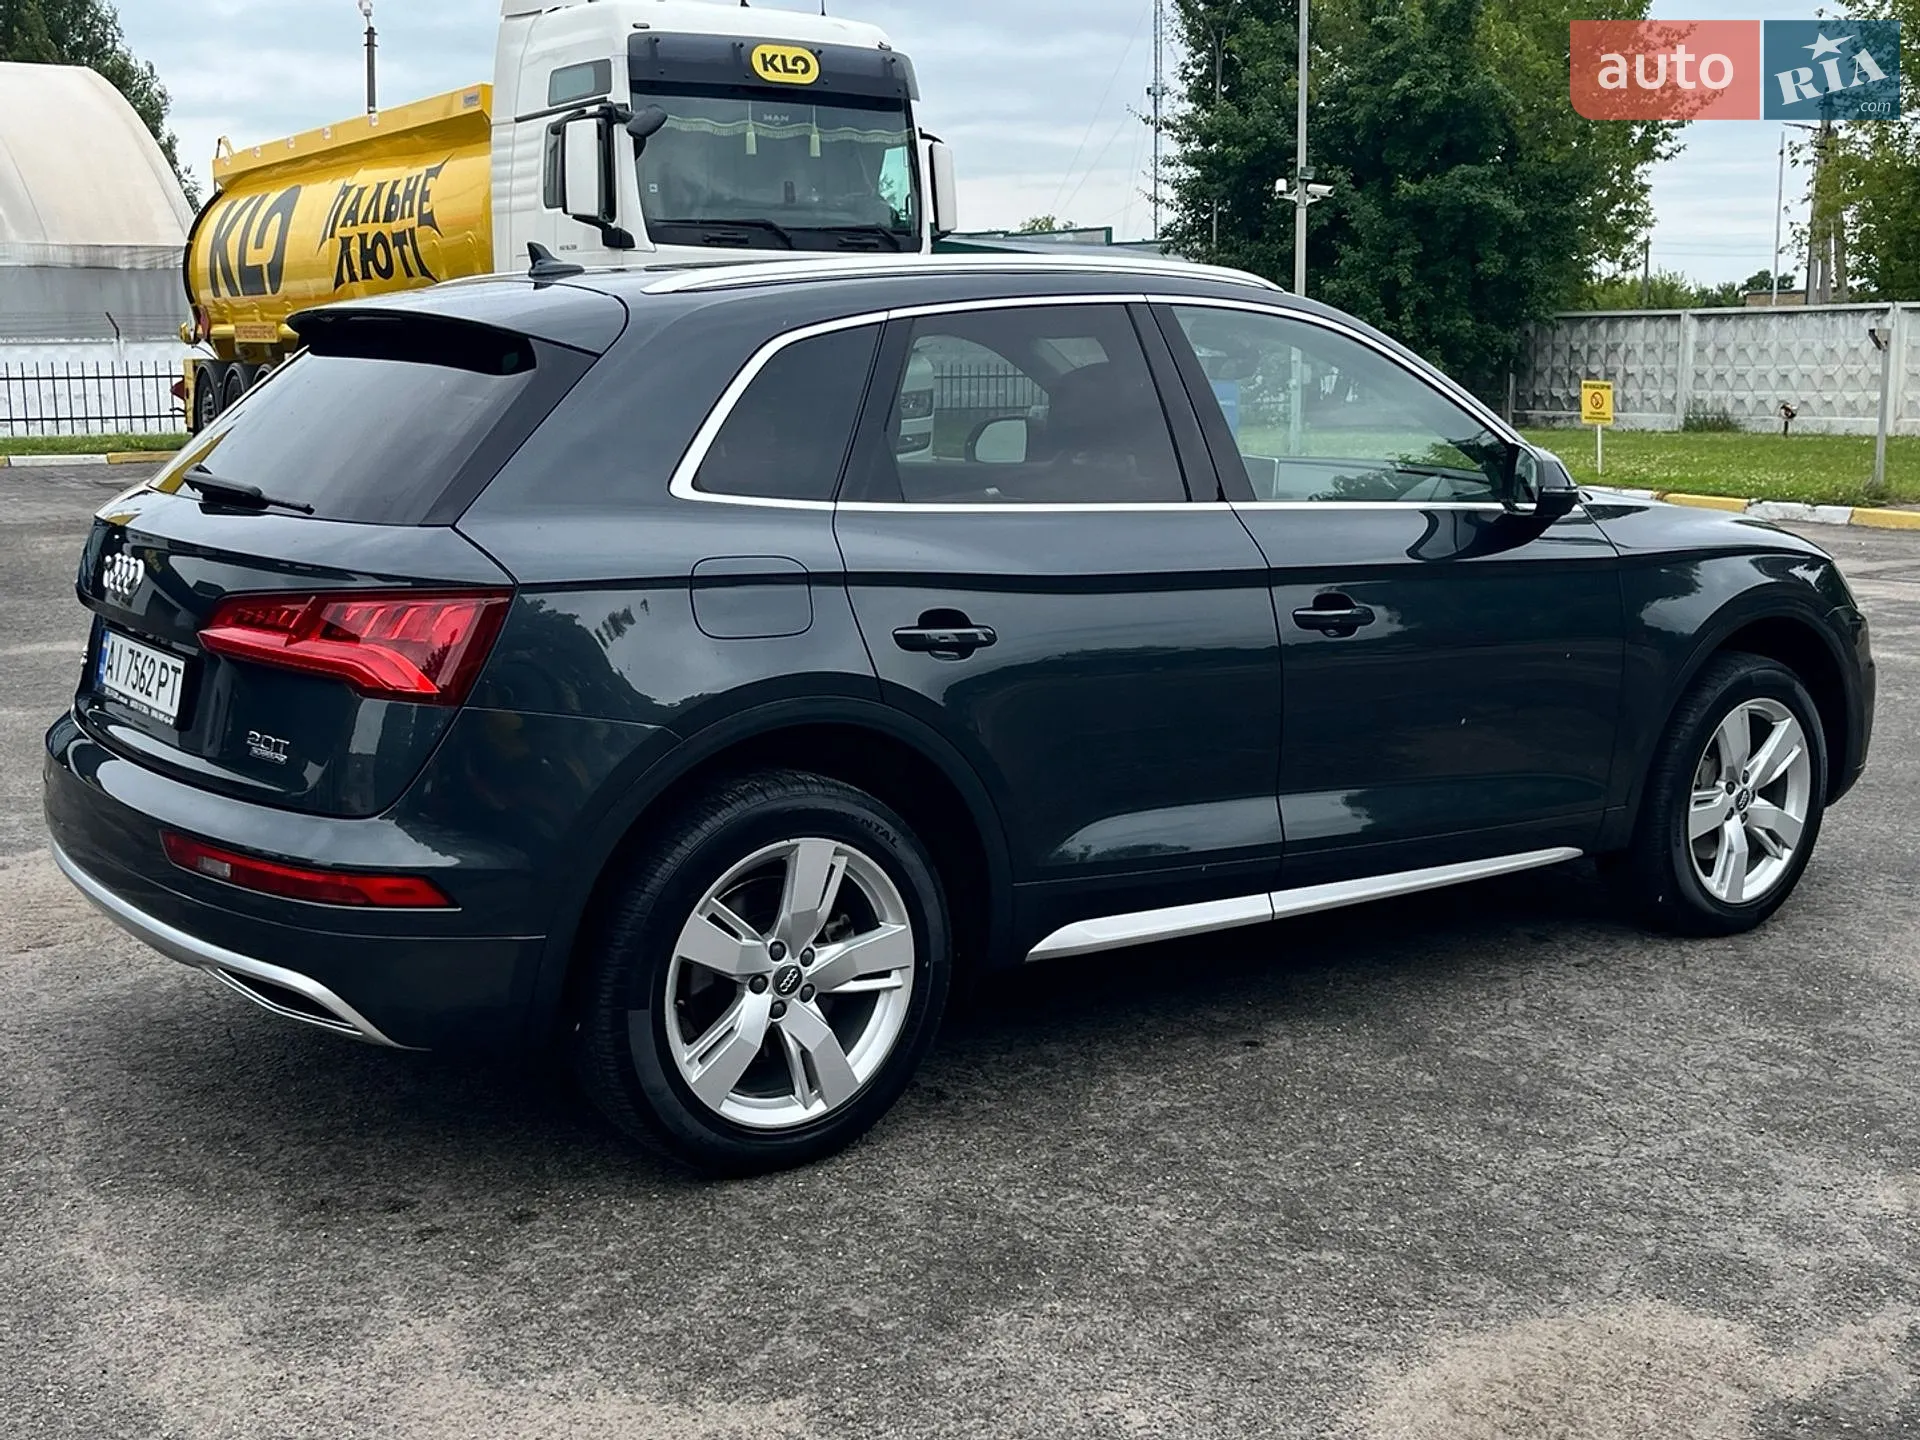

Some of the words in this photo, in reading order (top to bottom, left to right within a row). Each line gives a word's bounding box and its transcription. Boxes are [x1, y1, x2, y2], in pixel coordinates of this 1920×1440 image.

[761, 52, 811, 76] KLO
[317, 155, 453, 251] ПАЛЬНЕ
[209, 185, 302, 297] KLO
[333, 227, 439, 291] ЛЮТІ
[124, 648, 155, 697] 7562
[156, 662, 181, 707] PT
